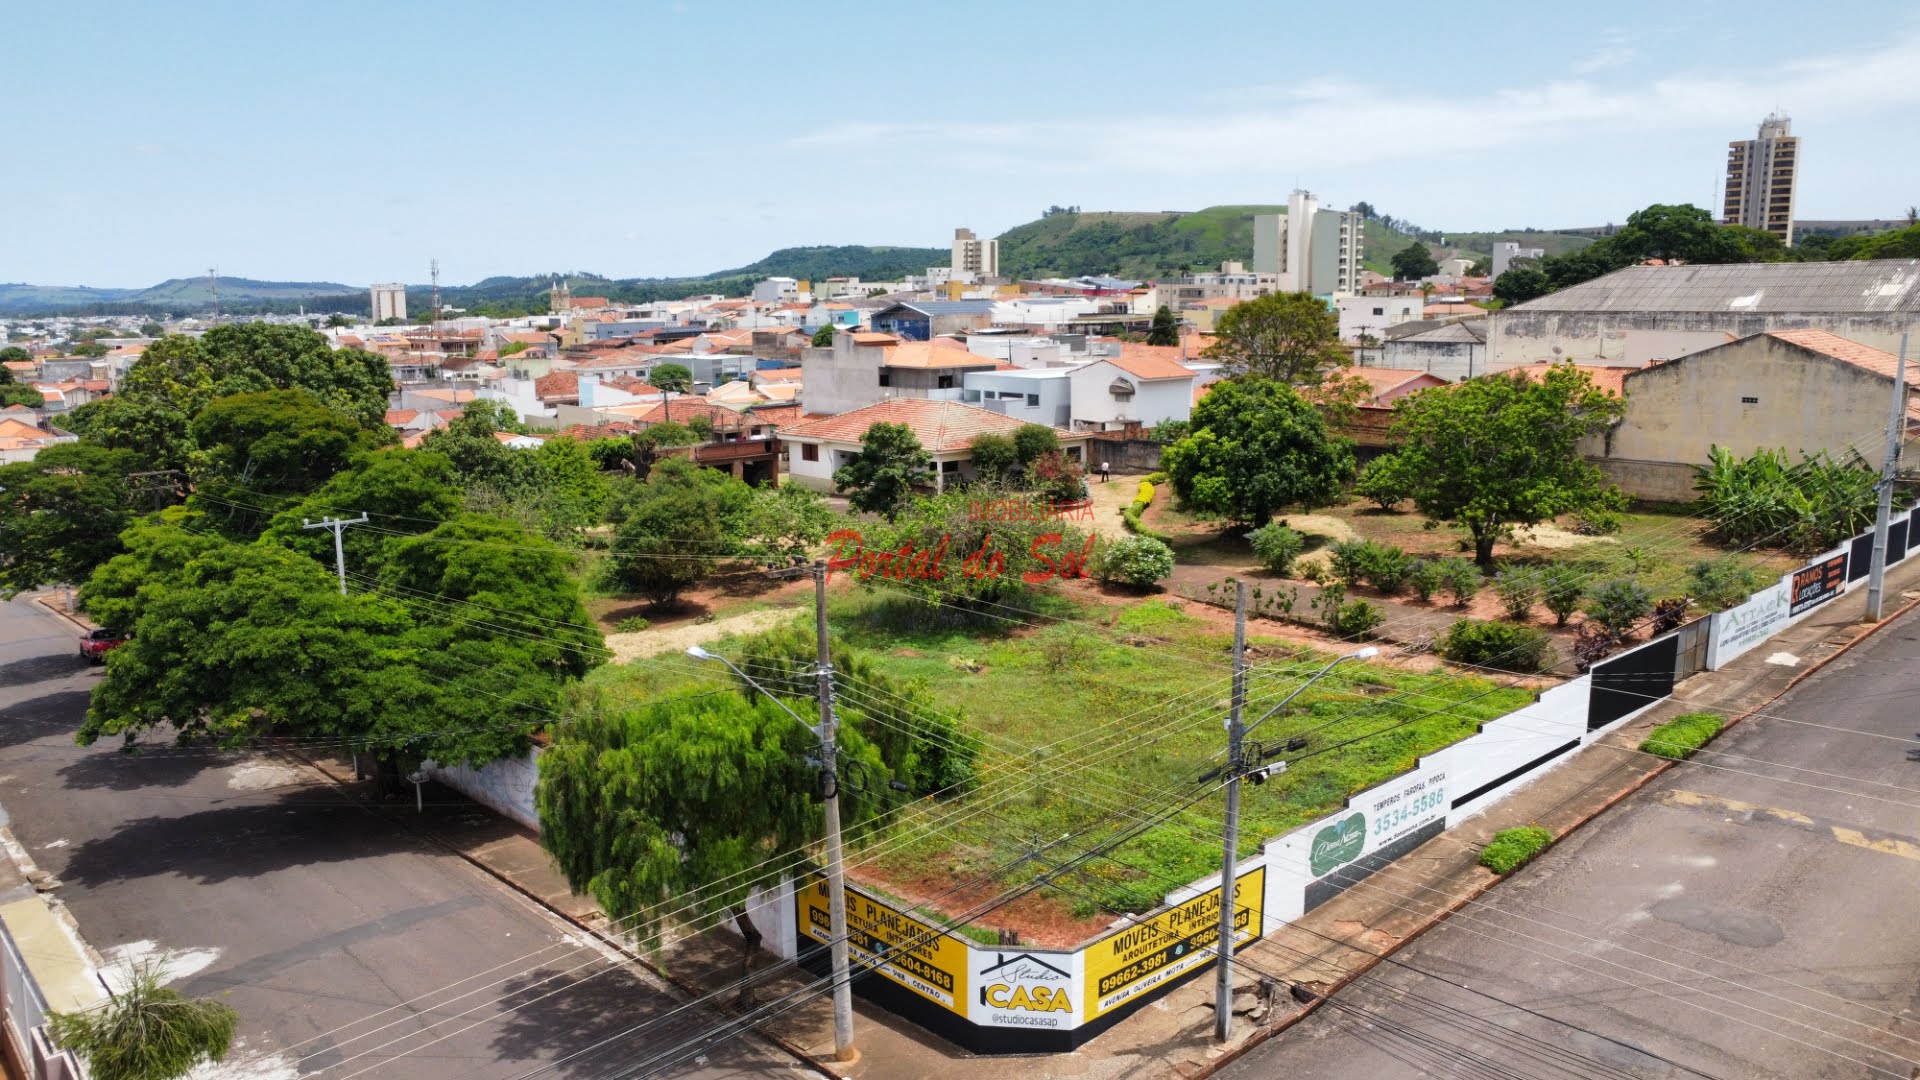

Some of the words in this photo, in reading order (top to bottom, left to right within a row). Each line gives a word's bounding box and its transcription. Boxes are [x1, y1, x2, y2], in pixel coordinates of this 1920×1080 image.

[1800, 565, 1824, 587] RAMOS
[1374, 788, 1444, 836] 3534-5586
[866, 902, 940, 952] PLANEJADOS
[1113, 920, 1159, 956] MÓVEIS
[1170, 882, 1241, 929] PLANEJAS
[1122, 930, 1180, 963] ARQUITETURA
[1188, 911, 1219, 931] INTERIO
[886, 931, 933, 960] INTERIORES
[1101, 951, 1168, 993] 99662-3981
[1189, 914, 1247, 950] 996068
[888, 948, 951, 988] 99604-8168
[988, 963, 1063, 984] Studio
[1103, 988, 1130, 1008] AVENIDA
[1134, 974, 1162, 993] OLIVEIRA
[1164, 962, 1184, 978] MOTA
[985, 983, 1073, 1013] CASA
[992, 1013, 1058, 1028] @studiocasasap
